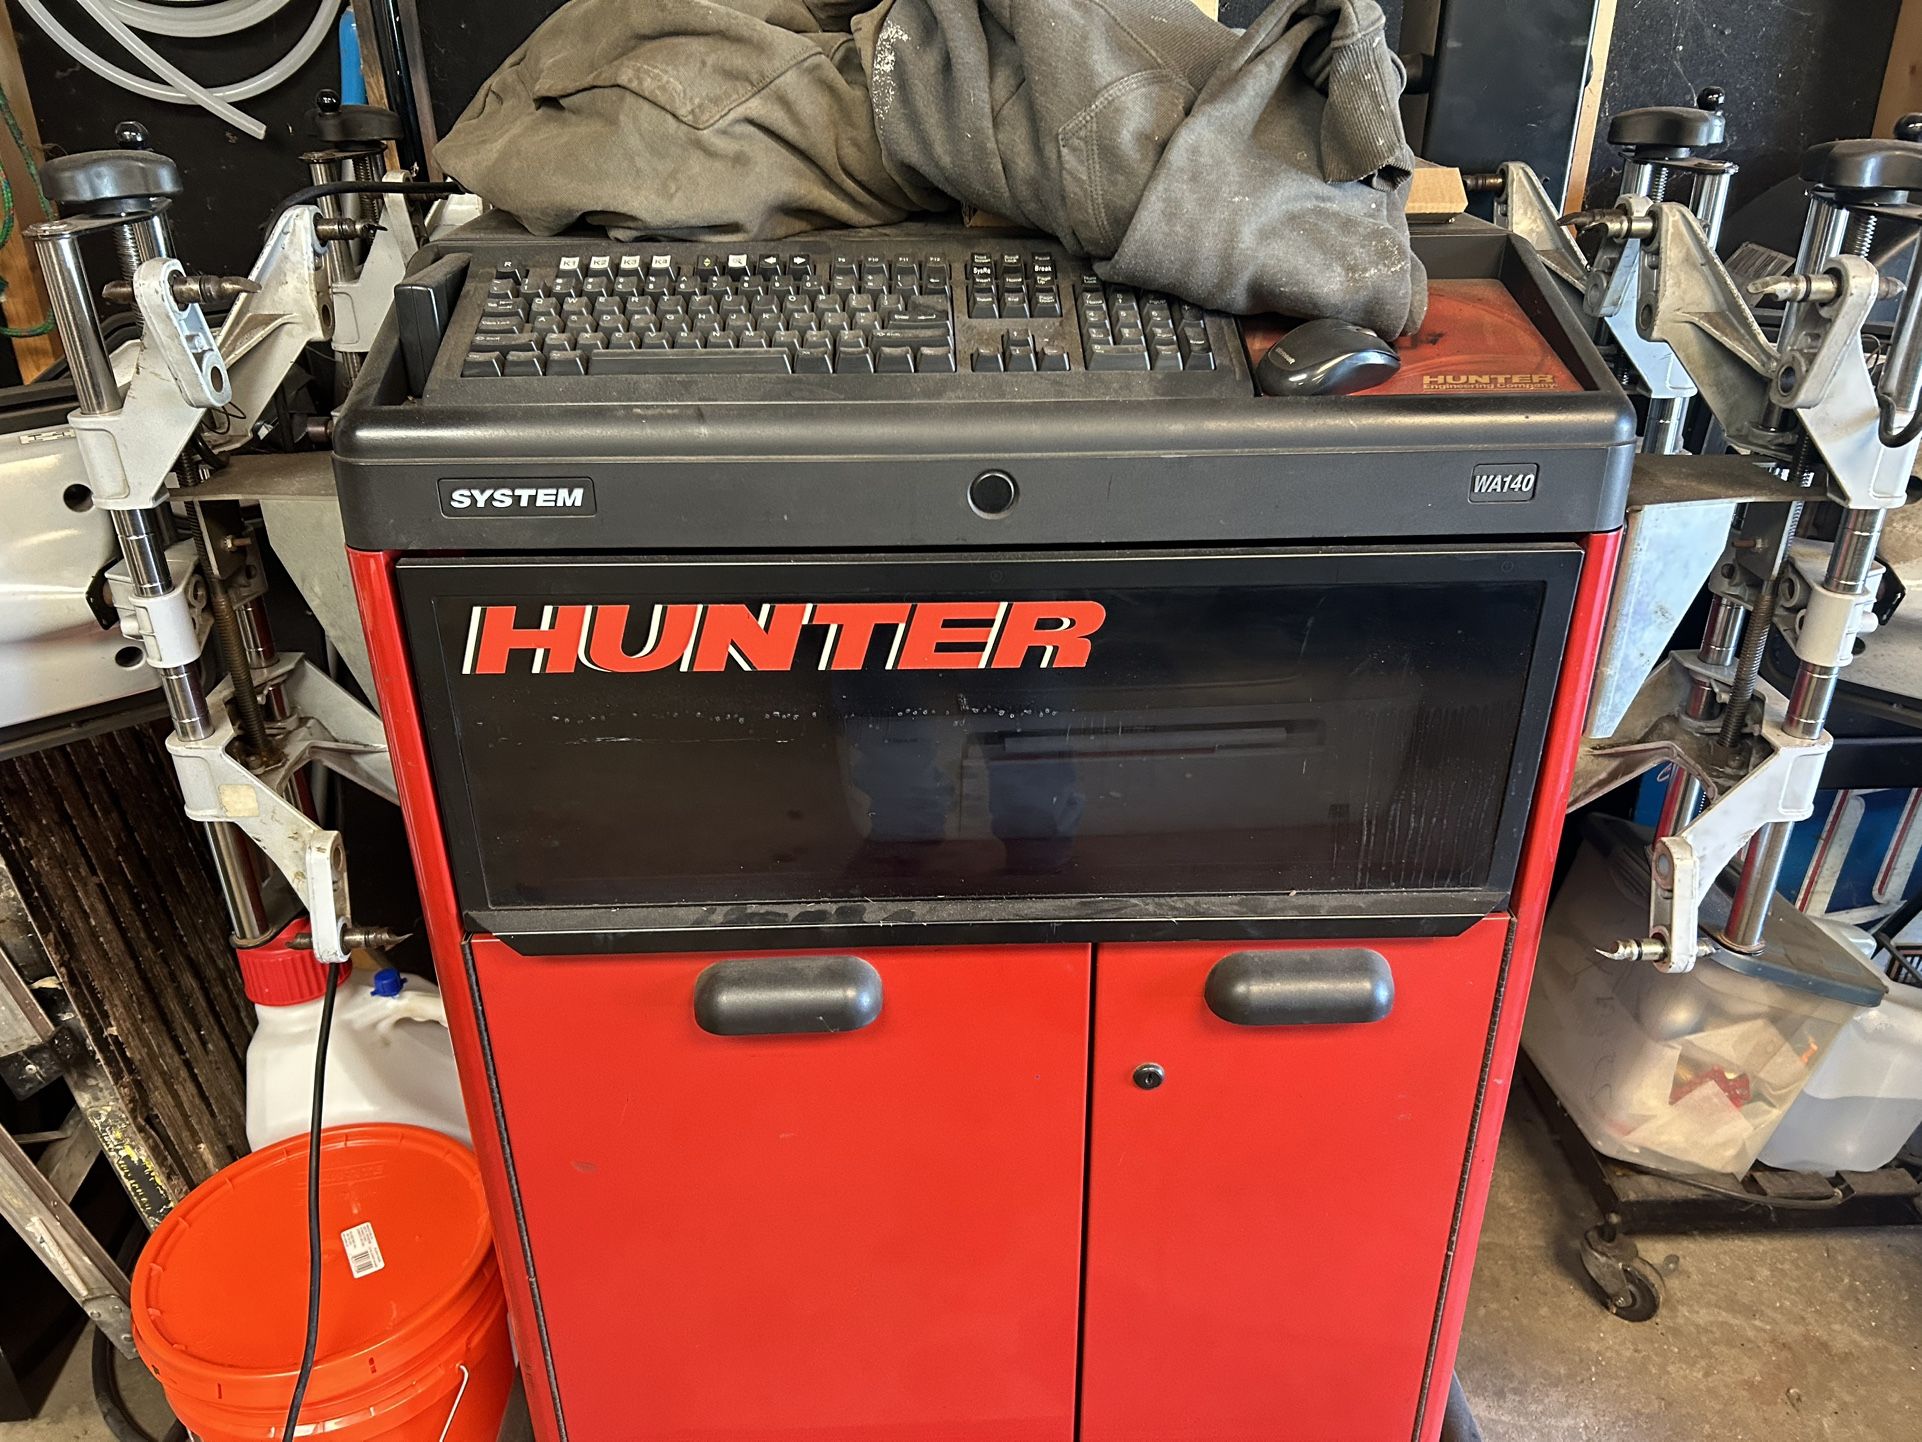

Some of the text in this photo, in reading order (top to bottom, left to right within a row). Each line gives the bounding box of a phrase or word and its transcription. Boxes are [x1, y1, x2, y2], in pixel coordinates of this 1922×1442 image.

[1423, 375, 1554, 384] HUNTER
[1473, 473, 1535, 493] WA140
[450, 487, 584, 509] SYSTEM
[462, 600, 1107, 675] HUNTER
